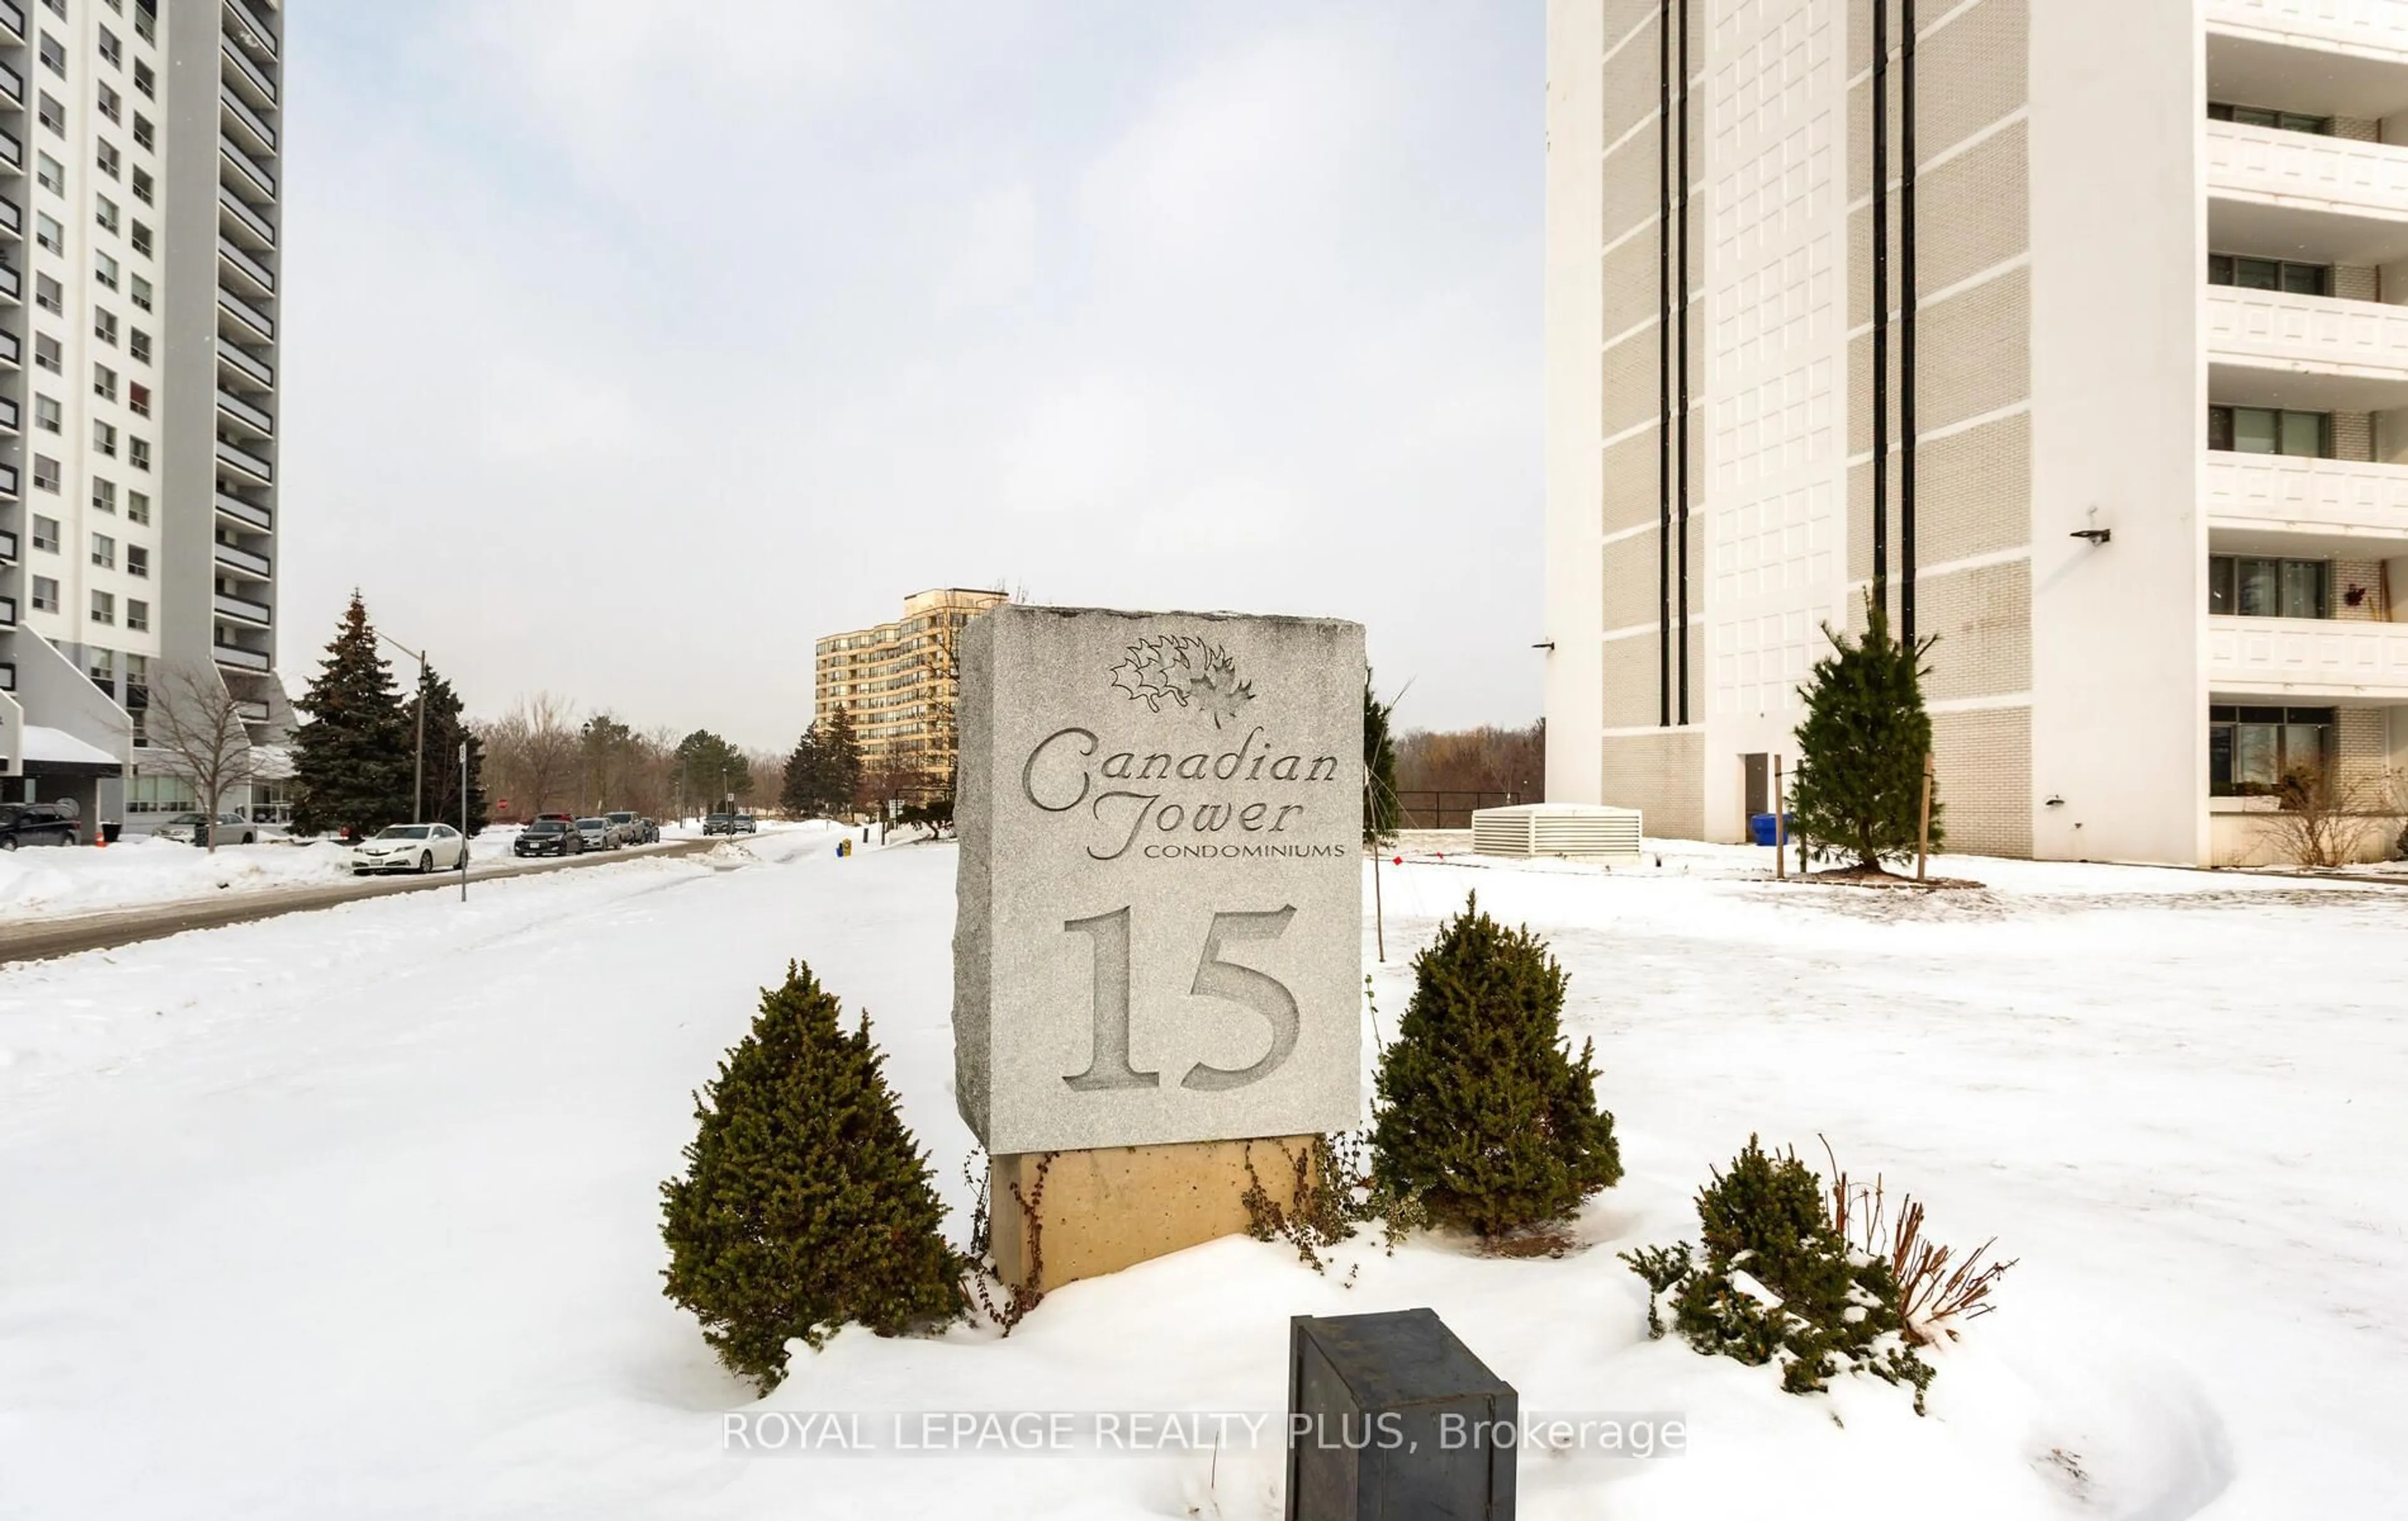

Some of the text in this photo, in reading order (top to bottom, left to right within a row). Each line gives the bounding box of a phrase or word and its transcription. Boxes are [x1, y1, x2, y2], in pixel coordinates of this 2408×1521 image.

[1022, 726, 1338, 812] Canadian
[1087, 790, 1304, 861] Tower
[1144, 844, 1345, 858] CONDOMINIUMS
[1062, 904, 1300, 1091] 15
